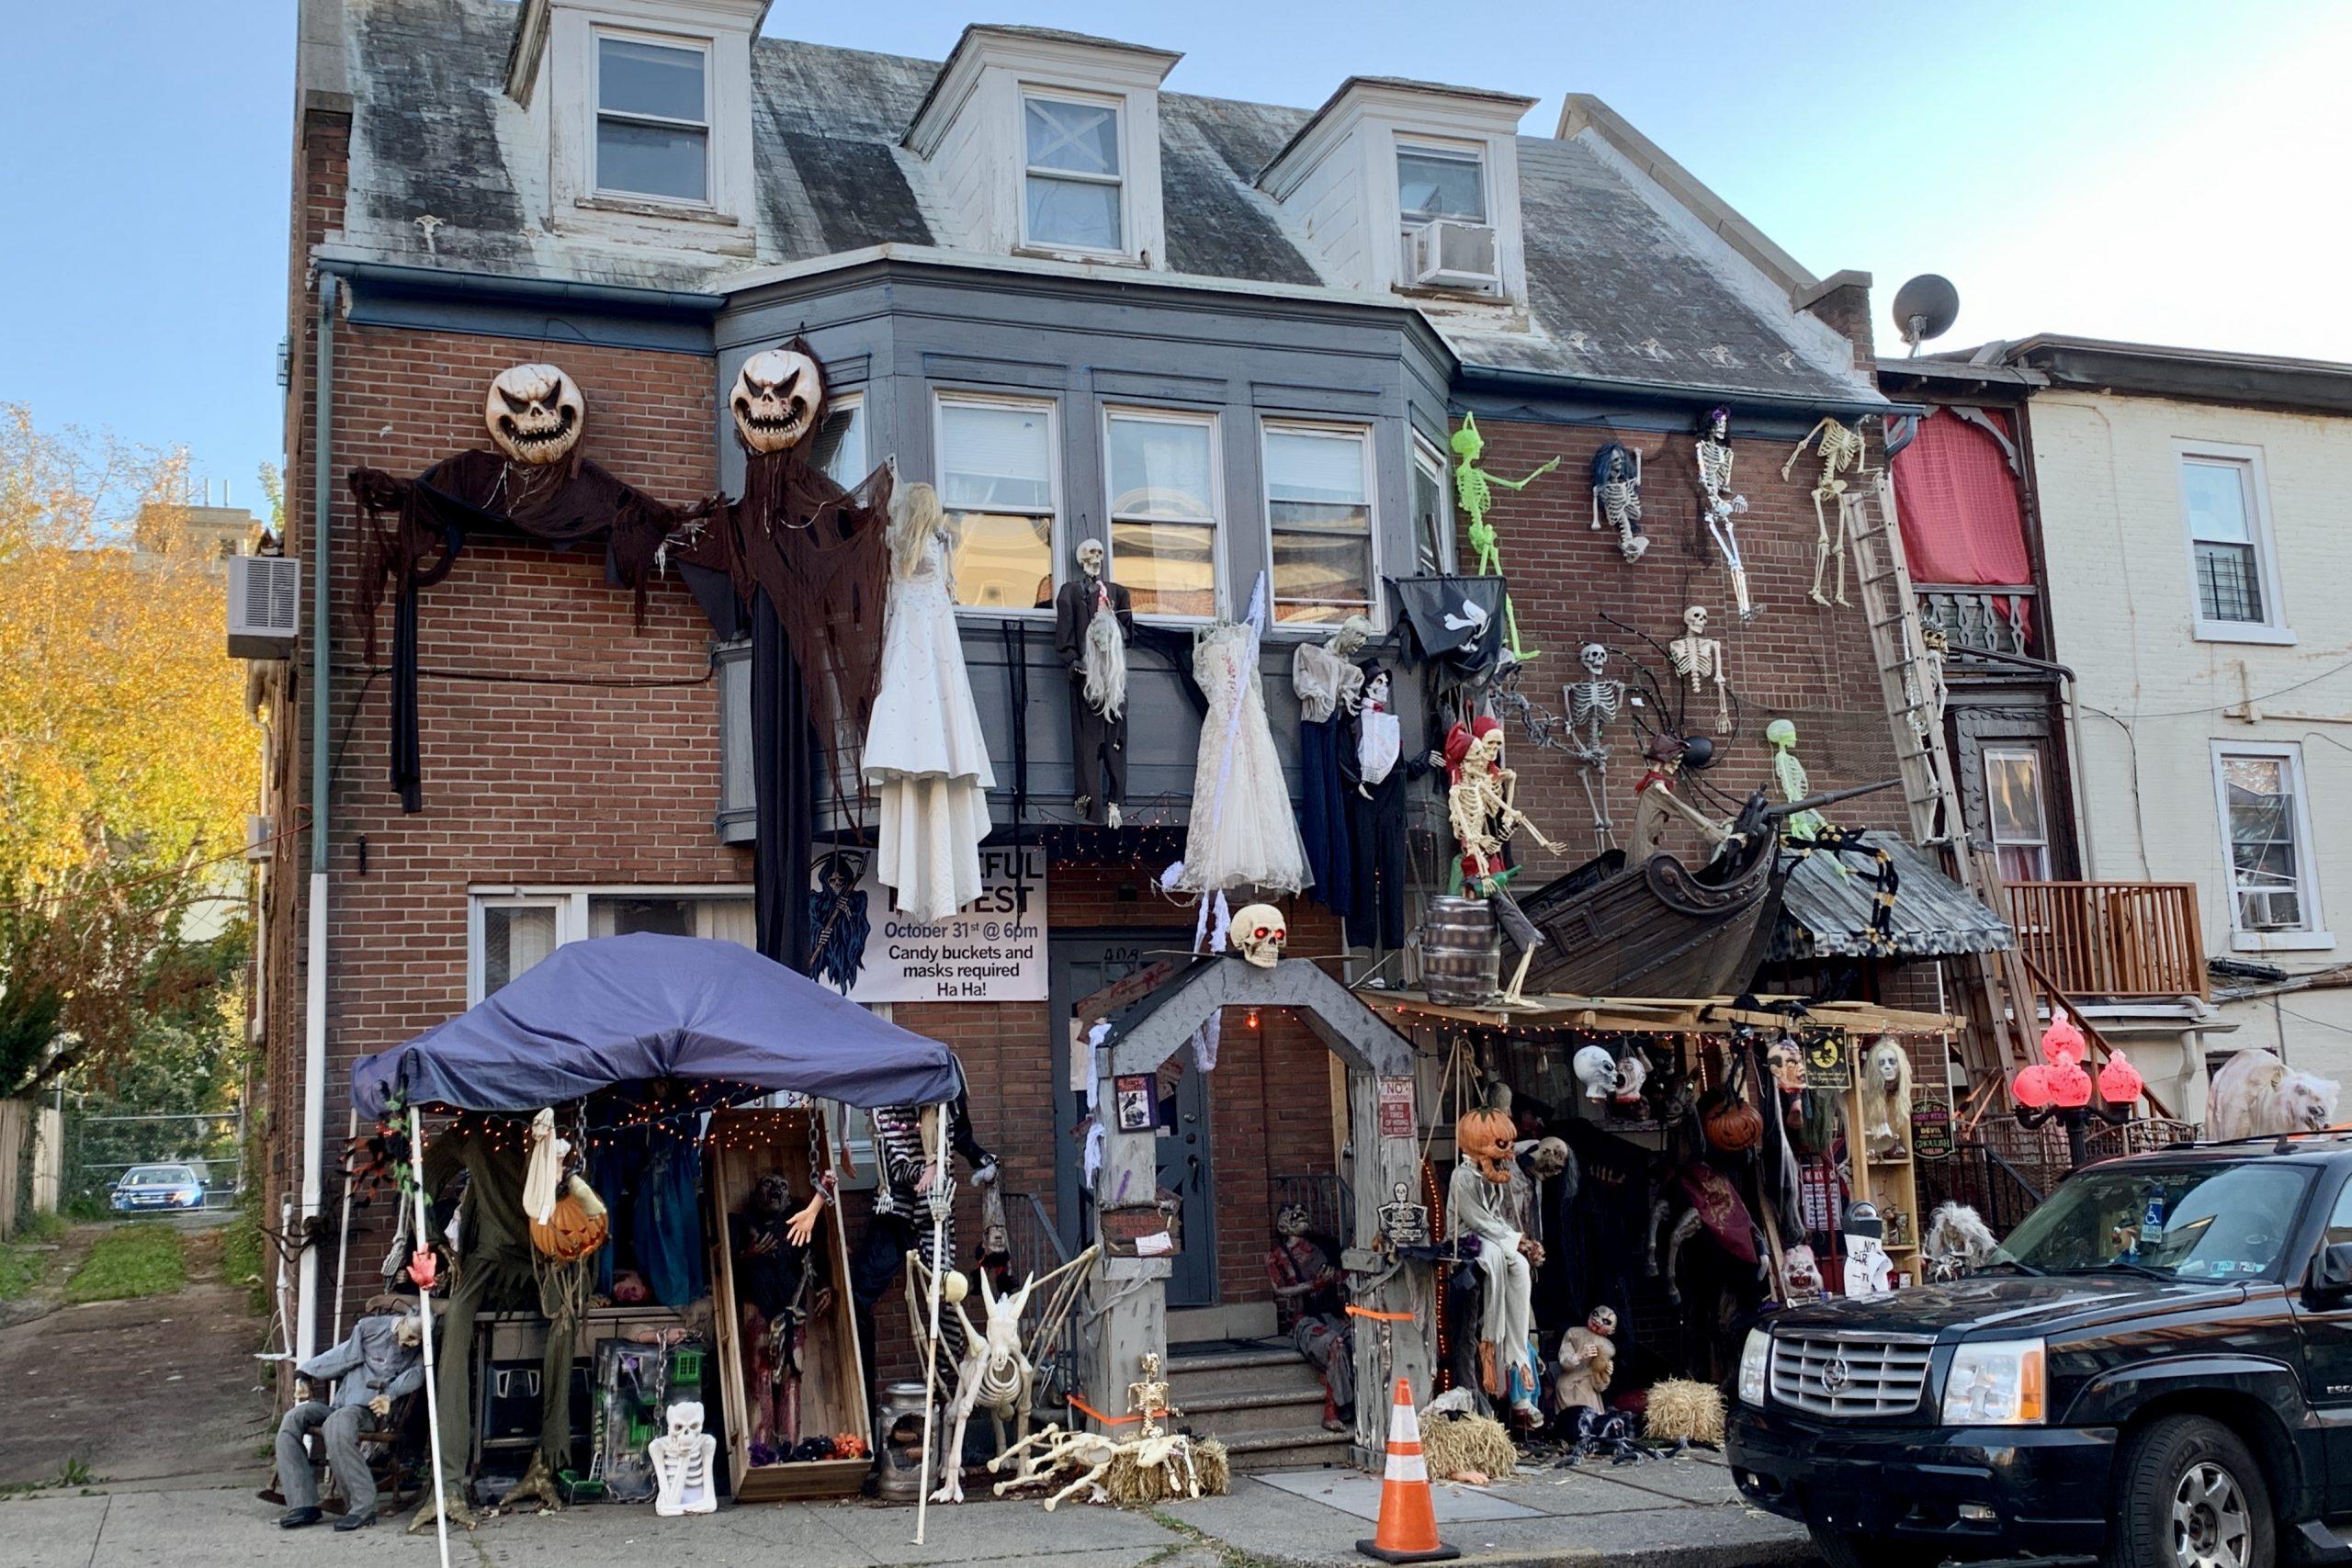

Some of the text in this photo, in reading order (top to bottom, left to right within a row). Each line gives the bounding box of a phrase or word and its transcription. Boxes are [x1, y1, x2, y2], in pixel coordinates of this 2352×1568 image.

[885, 921, 1038, 942] October 31st @ 6pm
[888, 945, 1034, 964] Candy buckets and
[903, 963, 1020, 980] masks required
[937, 982, 987, 997] Ha Ha!
[1386, 1082, 1403, 1094] NO
[1915, 1139, 1950, 1149] GHOULISH
[2326, 1385, 2352, 1394] ESC
